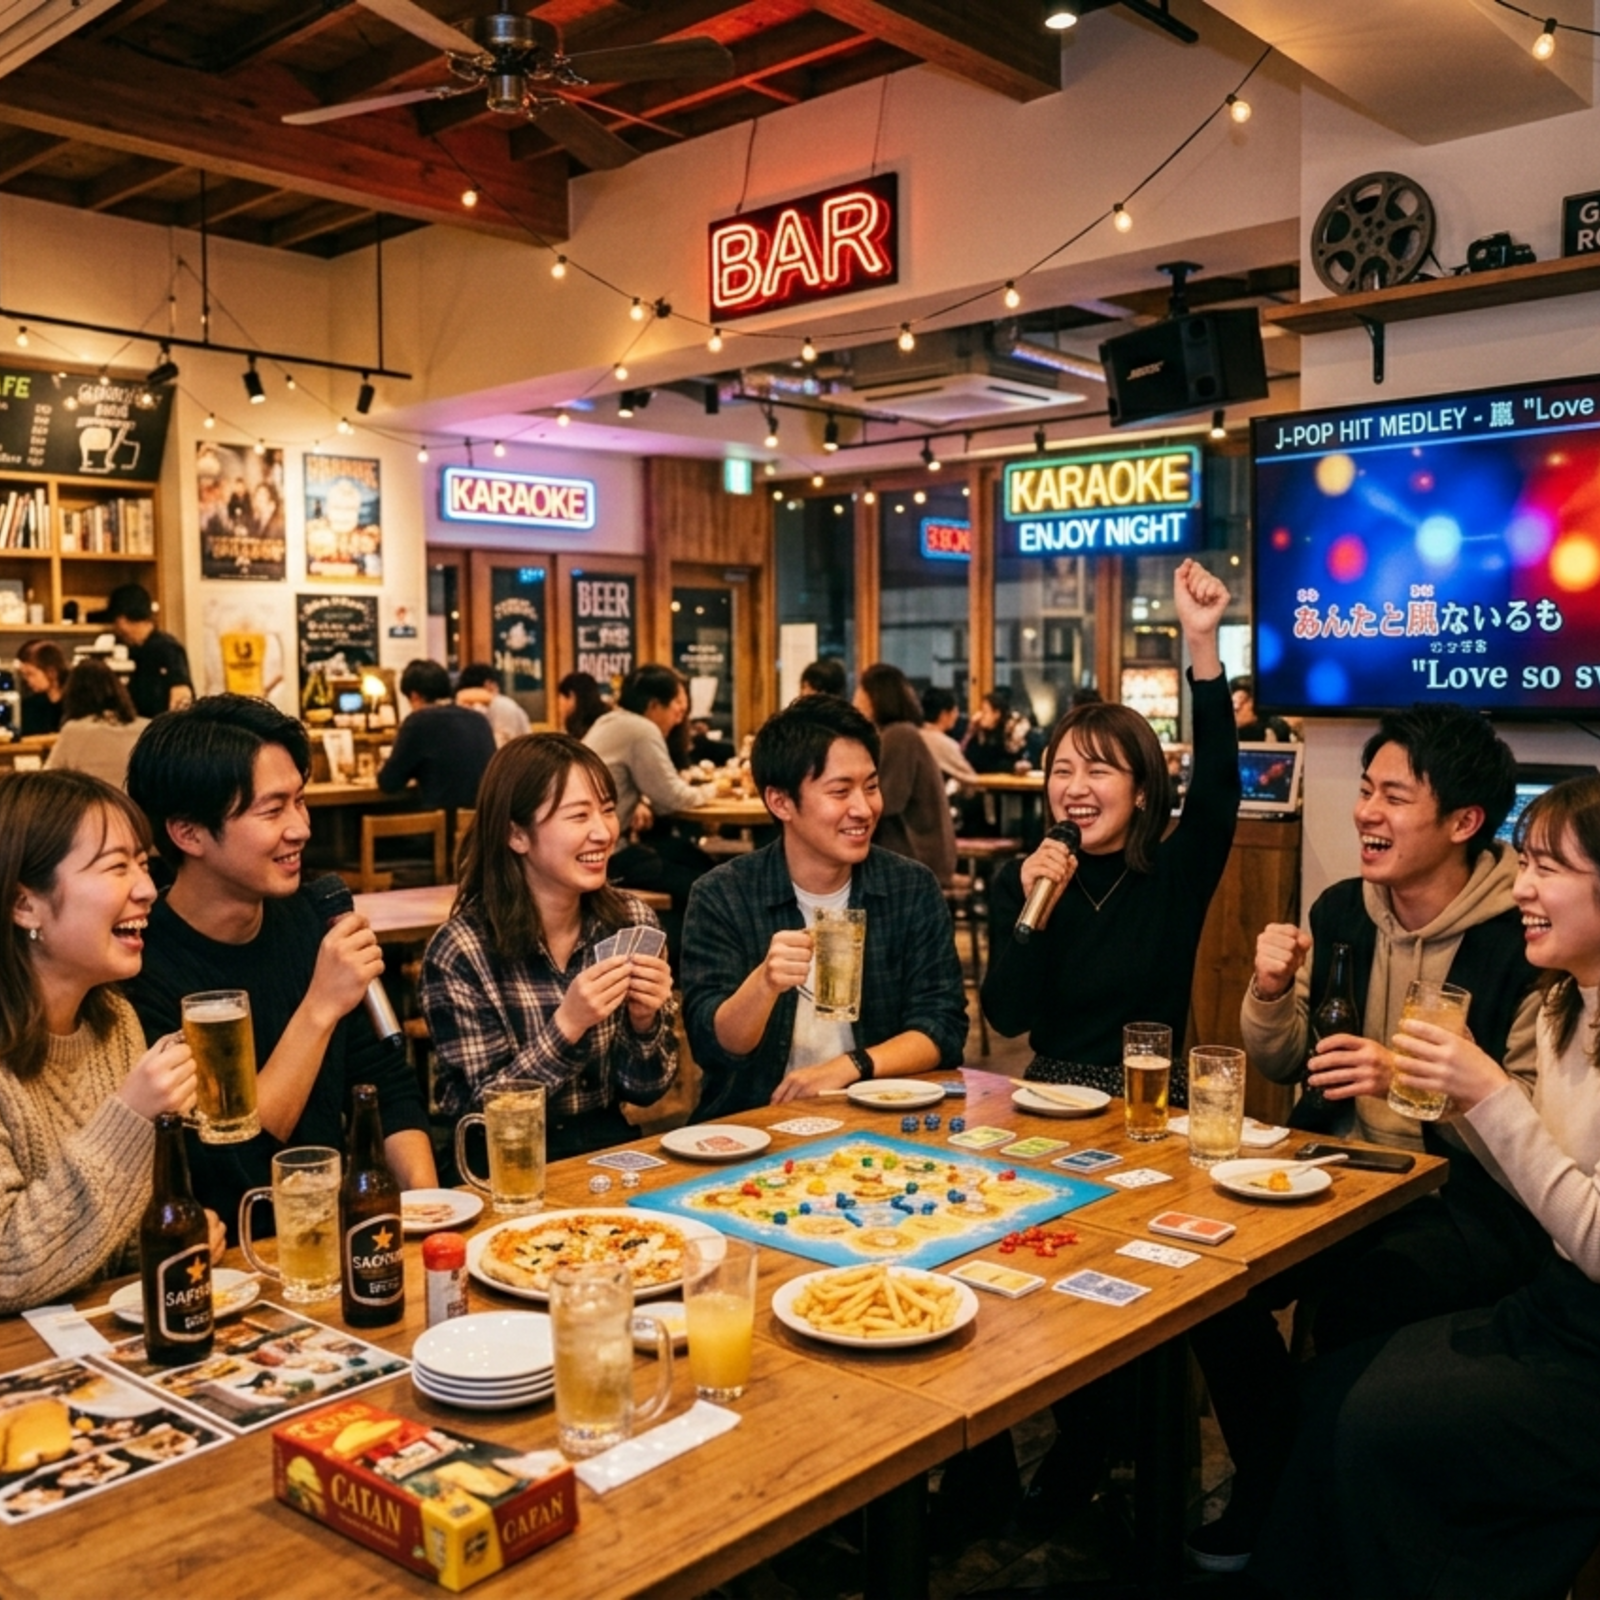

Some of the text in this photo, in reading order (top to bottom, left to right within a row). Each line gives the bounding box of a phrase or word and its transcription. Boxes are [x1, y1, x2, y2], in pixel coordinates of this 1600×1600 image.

[713, 191, 884, 308] BAR
[1577, 229, 1600, 251] R
[0, 375, 31, 399] FE
[1275, 422, 1334, 450] J-POP
[1339, 418, 1374, 442] HIT
[1379, 406, 1467, 438] MEDLEY
[1523, 396, 1594, 421] "Love
[451, 477, 587, 521] KARAOKE
[1010, 453, 1191, 514] KARAOKE
[1019, 511, 1187, 552] ENJOY NIGHT
[577, 581, 631, 618] BEER
[1412, 657, 1508, 690] "Love
[1522, 665, 1561, 690] so
